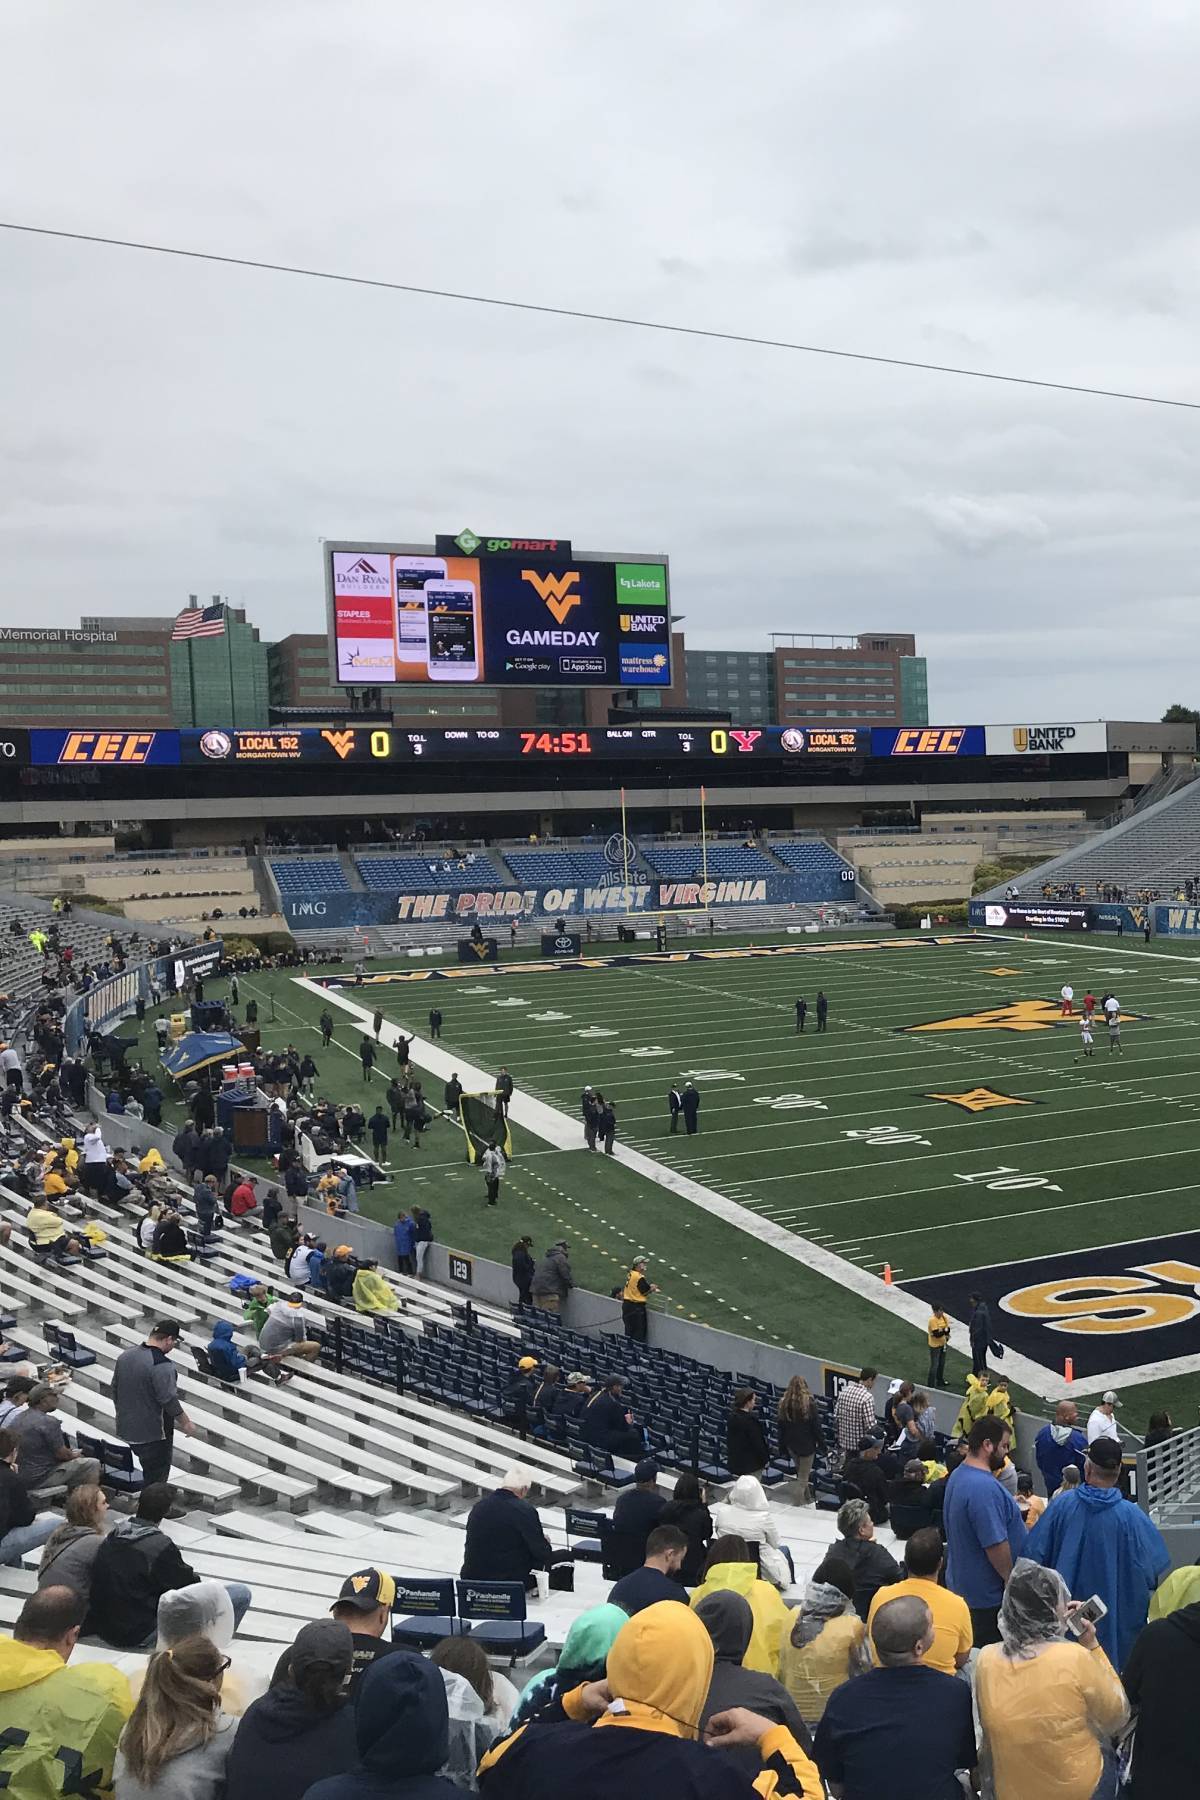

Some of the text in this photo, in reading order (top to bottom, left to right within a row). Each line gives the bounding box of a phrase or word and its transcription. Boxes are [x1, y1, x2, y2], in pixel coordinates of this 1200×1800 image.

[487, 539, 557, 552] gomart
[337, 574, 389, 585] DAN RYAN
[632, 579, 660, 589] Lakota
[337, 610, 371, 618] STAPLES
[631, 615, 666, 624] UNITED
[631, 623, 657, 632] BANK
[0, 628, 117, 643] Memorial Hospital
[506, 630, 600, 647] GAMEDAY
[514, 662, 537, 671] Google
[621, 657, 653, 665] mattress
[622, 665, 660, 673] warehouse
[445, 731, 468, 739] DOWN
[476, 731, 500, 739] TO GO
[607, 730, 633, 738] BALL ON
[641, 730, 657, 738] QTR
[1028, 727, 1076, 739] UNITED
[239, 737, 298, 750] LOCAL 152
[371, 731, 390, 757] 0
[520, 733, 592, 753] 74:51
[710, 730, 727, 753] 0
[810, 734, 854, 745] LOCAL 152
[896, 731, 963, 752] CEC
[1028, 739, 1064, 751] BANK
[62, 734, 153, 760] CEC
[413, 744, 423, 755] 3
[682, 742, 691, 752] 3
[597, 868, 647, 887] Allstate
[398, 879, 767, 919] THE PRIDE OF WEST VIRGINIA
[292, 900, 327, 917] IMG
[752, 1093, 822, 1109] 30
[839, 1126, 921, 1145] 20
[953, 1166, 1049, 1190] 10
[453, 1259, 467, 1280] 129
[405, 1588, 441, 1598] Panhandle
